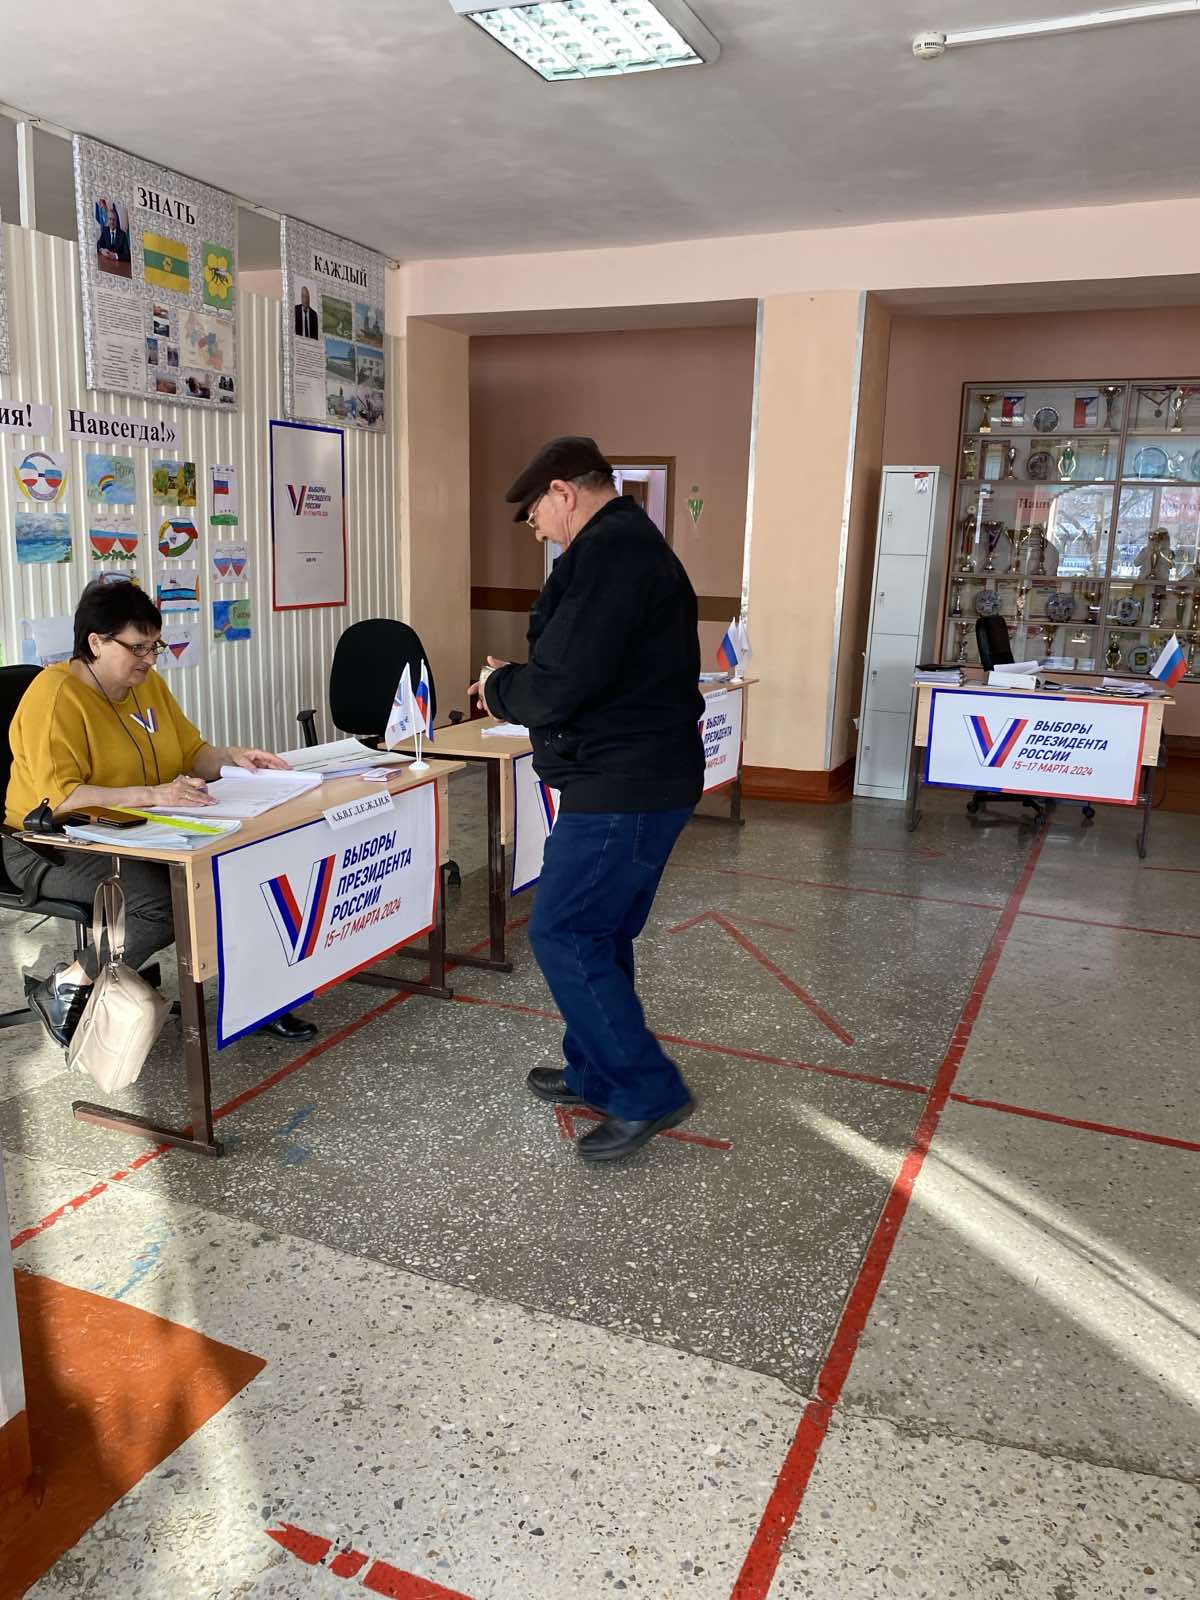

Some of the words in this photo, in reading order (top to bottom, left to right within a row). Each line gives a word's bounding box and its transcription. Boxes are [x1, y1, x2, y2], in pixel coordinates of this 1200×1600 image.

[138, 187, 195, 225] ЗНАТЬ
[314, 255, 367, 287] КАЖДЫЙ
[69, 410, 176, 443] Навсегда!»
[1025, 734, 1108, 750] ПРЕЗИДЕНТА
[1034, 721, 1093, 734] ВЫБОРЫ
[1018, 748, 1071, 761] РОССИИ
[1039, 763, 1069, 773] МАРТА
[1070, 766, 1093, 776] 2024
[343, 831, 396, 869] ВЫБОРЫ
[337, 848, 412, 897] ПРЕЗИДЕНТА
[331, 885, 381, 924] РОССИИ
[351, 906, 380, 937] МАРТА
[380, 896, 402, 922] 2024
